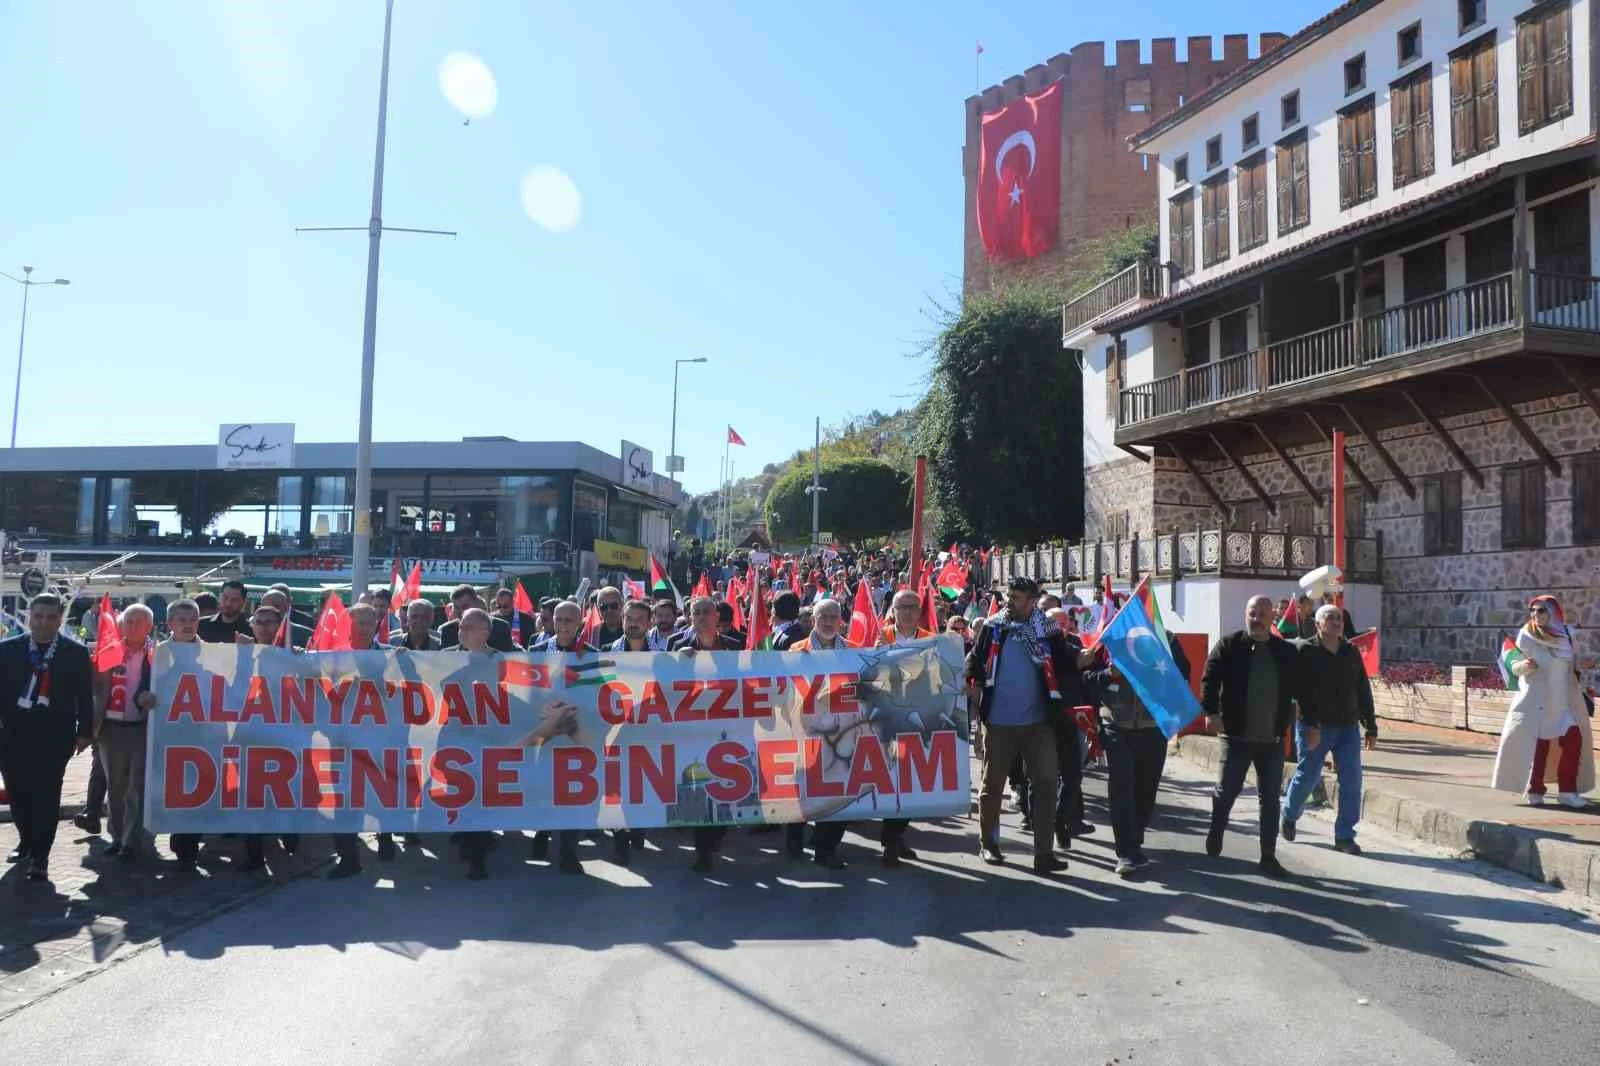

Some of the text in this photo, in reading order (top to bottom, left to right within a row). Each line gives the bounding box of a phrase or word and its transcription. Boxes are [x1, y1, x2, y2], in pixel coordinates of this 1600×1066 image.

[167, 671, 861, 726] ALANYA'DAN GAZZE'YE
[704, 730, 960, 803] SELAM
